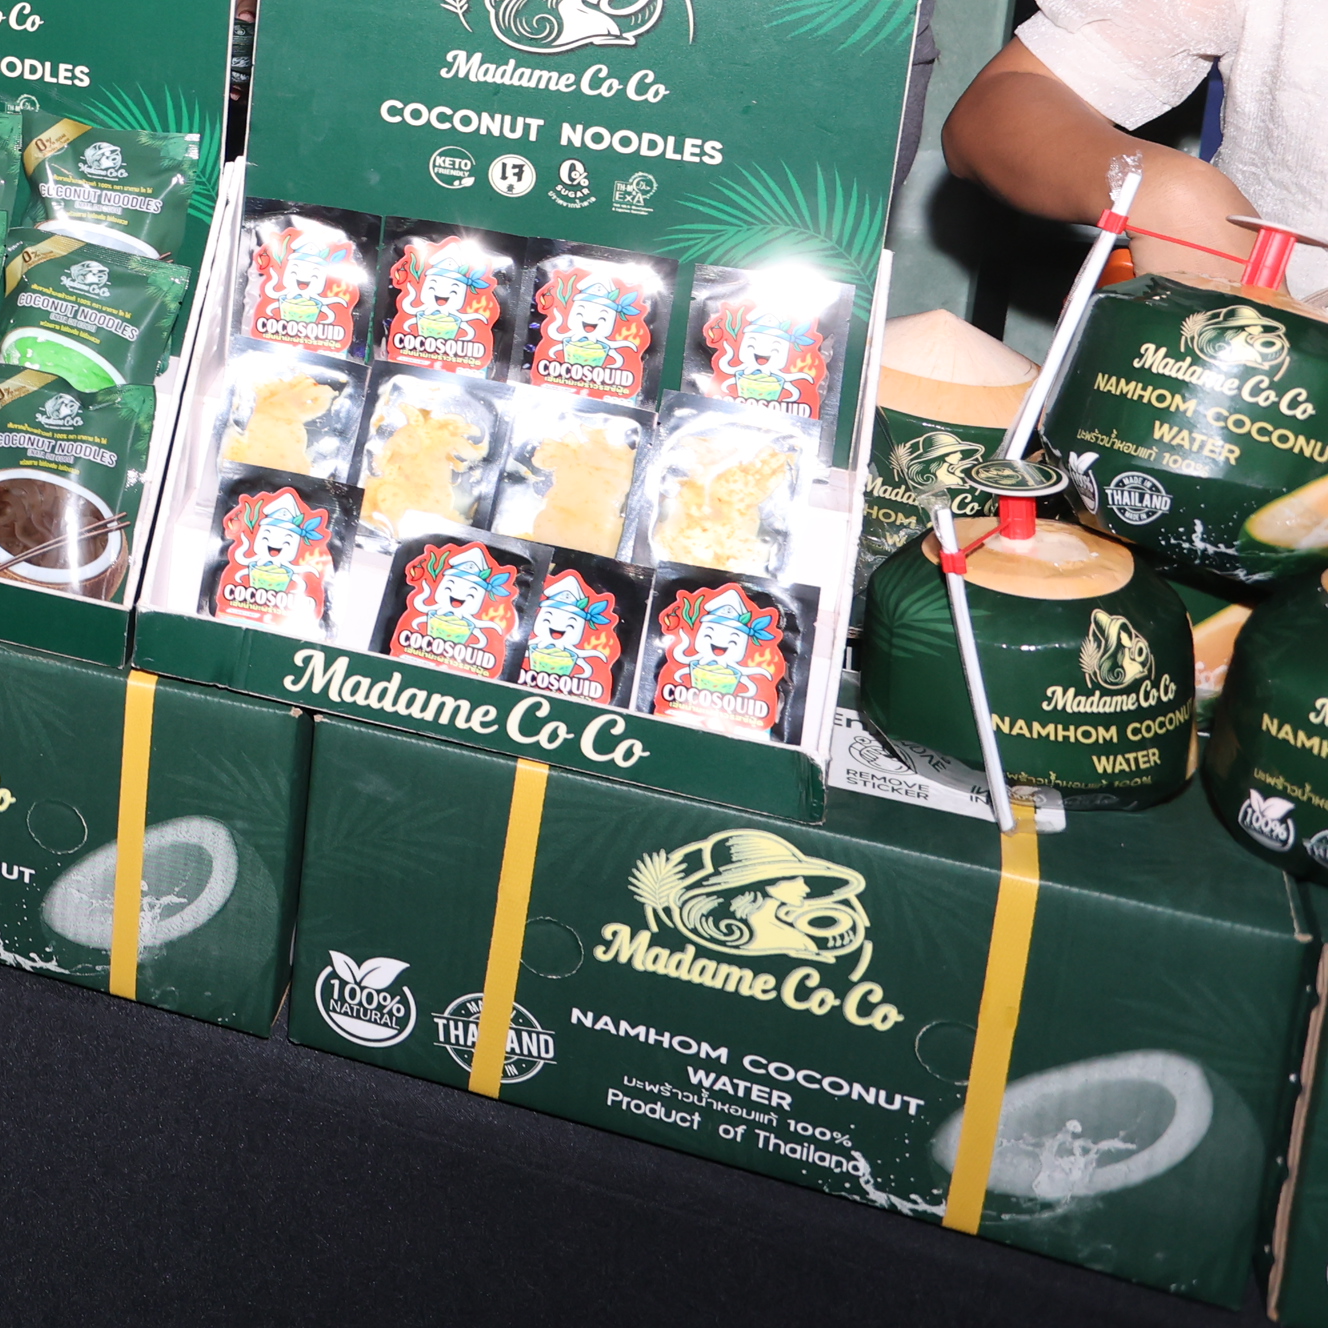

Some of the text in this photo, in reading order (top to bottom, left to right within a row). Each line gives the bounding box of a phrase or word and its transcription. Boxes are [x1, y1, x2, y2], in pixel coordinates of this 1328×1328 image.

[7, 0, 44, 33] Co
[440, 50, 669, 104] Madame Co Co
[379, 99, 723, 166] COCONUT NOODLES
[434, 166, 470, 178] FRIENDLY
[435, 155, 472, 171] KETO
[559, 158, 589, 187] 0%
[101, 190, 163, 214] NOODLES
[555, 184, 591, 198] SUGAR
[17, 292, 78, 317] COCONUT
[77, 305, 140, 342] NOODLES
[255, 316, 346, 341] COCOSQUID
[393, 333, 485, 358] COCOSQUID
[537, 358, 635, 387] COCOSQUID
[1132, 342, 1316, 420] Madame Co Co
[1093, 372, 1328, 464] NAMHOM COCONU
[55, 440, 118, 468] NOODLES
[1152, 420, 1241, 466] WATER
[1122, 476, 1144, 487] MADE
[1161, 451, 1211, 479] 100%
[951, 493, 982, 516] Co
[1105, 488, 1172, 512] THAILAND
[1124, 510, 1140, 521] MADE
[399, 629, 496, 668] COCOSQUID
[517, 669, 603, 699] COSQUID
[662, 683, 769, 718] COCOSQUID
[1041, 673, 1177, 714] Madame Co Co
[282, 648, 651, 769] Madame Co Co
[990, 697, 1193, 744] NAMHOM COCONUT
[1261, 712, 1328, 759] NAM
[1091, 747, 1162, 775] WATER
[846, 768, 930, 793] REMOVE
[846, 779, 930, 802] STICKER
[1245, 806, 1289, 841] 100%
[593, 923, 905, 1032] Madame Co Co
[328, 998, 401, 1030] NATURAL
[329, 978, 405, 1018] 100%
[433, 1017, 556, 1059] THAAND
[570, 1007, 925, 1118] NAMHOM COCONUT
[687, 1065, 793, 1112] WATER
[623, 1074, 853, 1148] มะพร้าวน้ำหอมแท้ 100%
[606, 1087, 870, 1178] Product of Thailand
